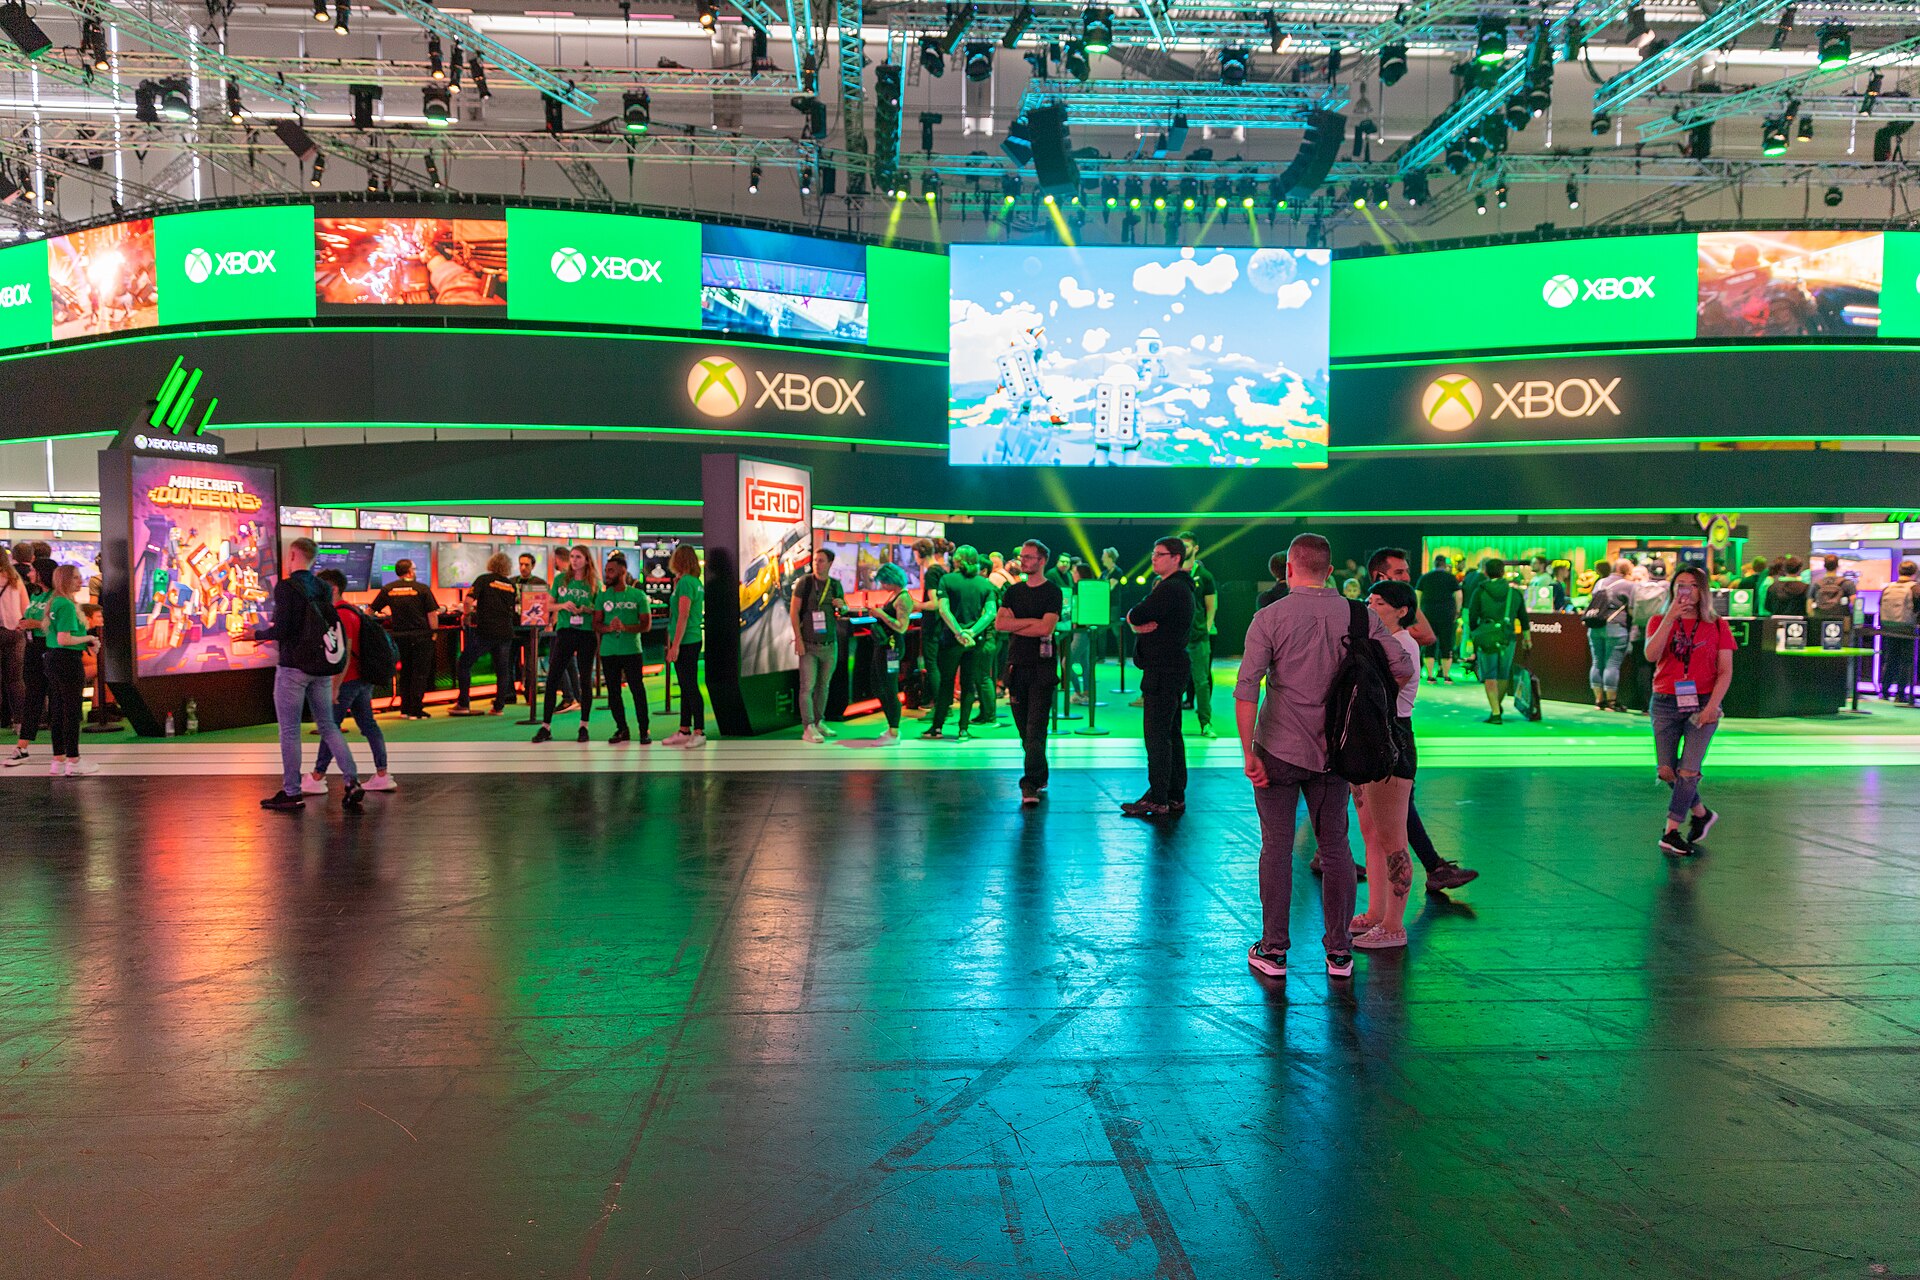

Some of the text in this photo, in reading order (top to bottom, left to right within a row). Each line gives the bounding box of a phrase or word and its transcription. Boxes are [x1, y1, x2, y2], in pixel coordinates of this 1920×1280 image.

[215, 249, 277, 276] XBOX
[590, 255, 663, 283] XBOX
[1581, 275, 1656, 302] XBOX
[754, 370, 867, 417] XBOX
[1490, 377, 1622, 420] XBOX
[147, 437, 219, 456] XBOX GAME PASS
[167, 475, 244, 493] MINECRAFT
[158, 486, 255, 511] DUNGEONS
[751, 488, 800, 514] GRID
[1529, 621, 1562, 634] icrosoft
